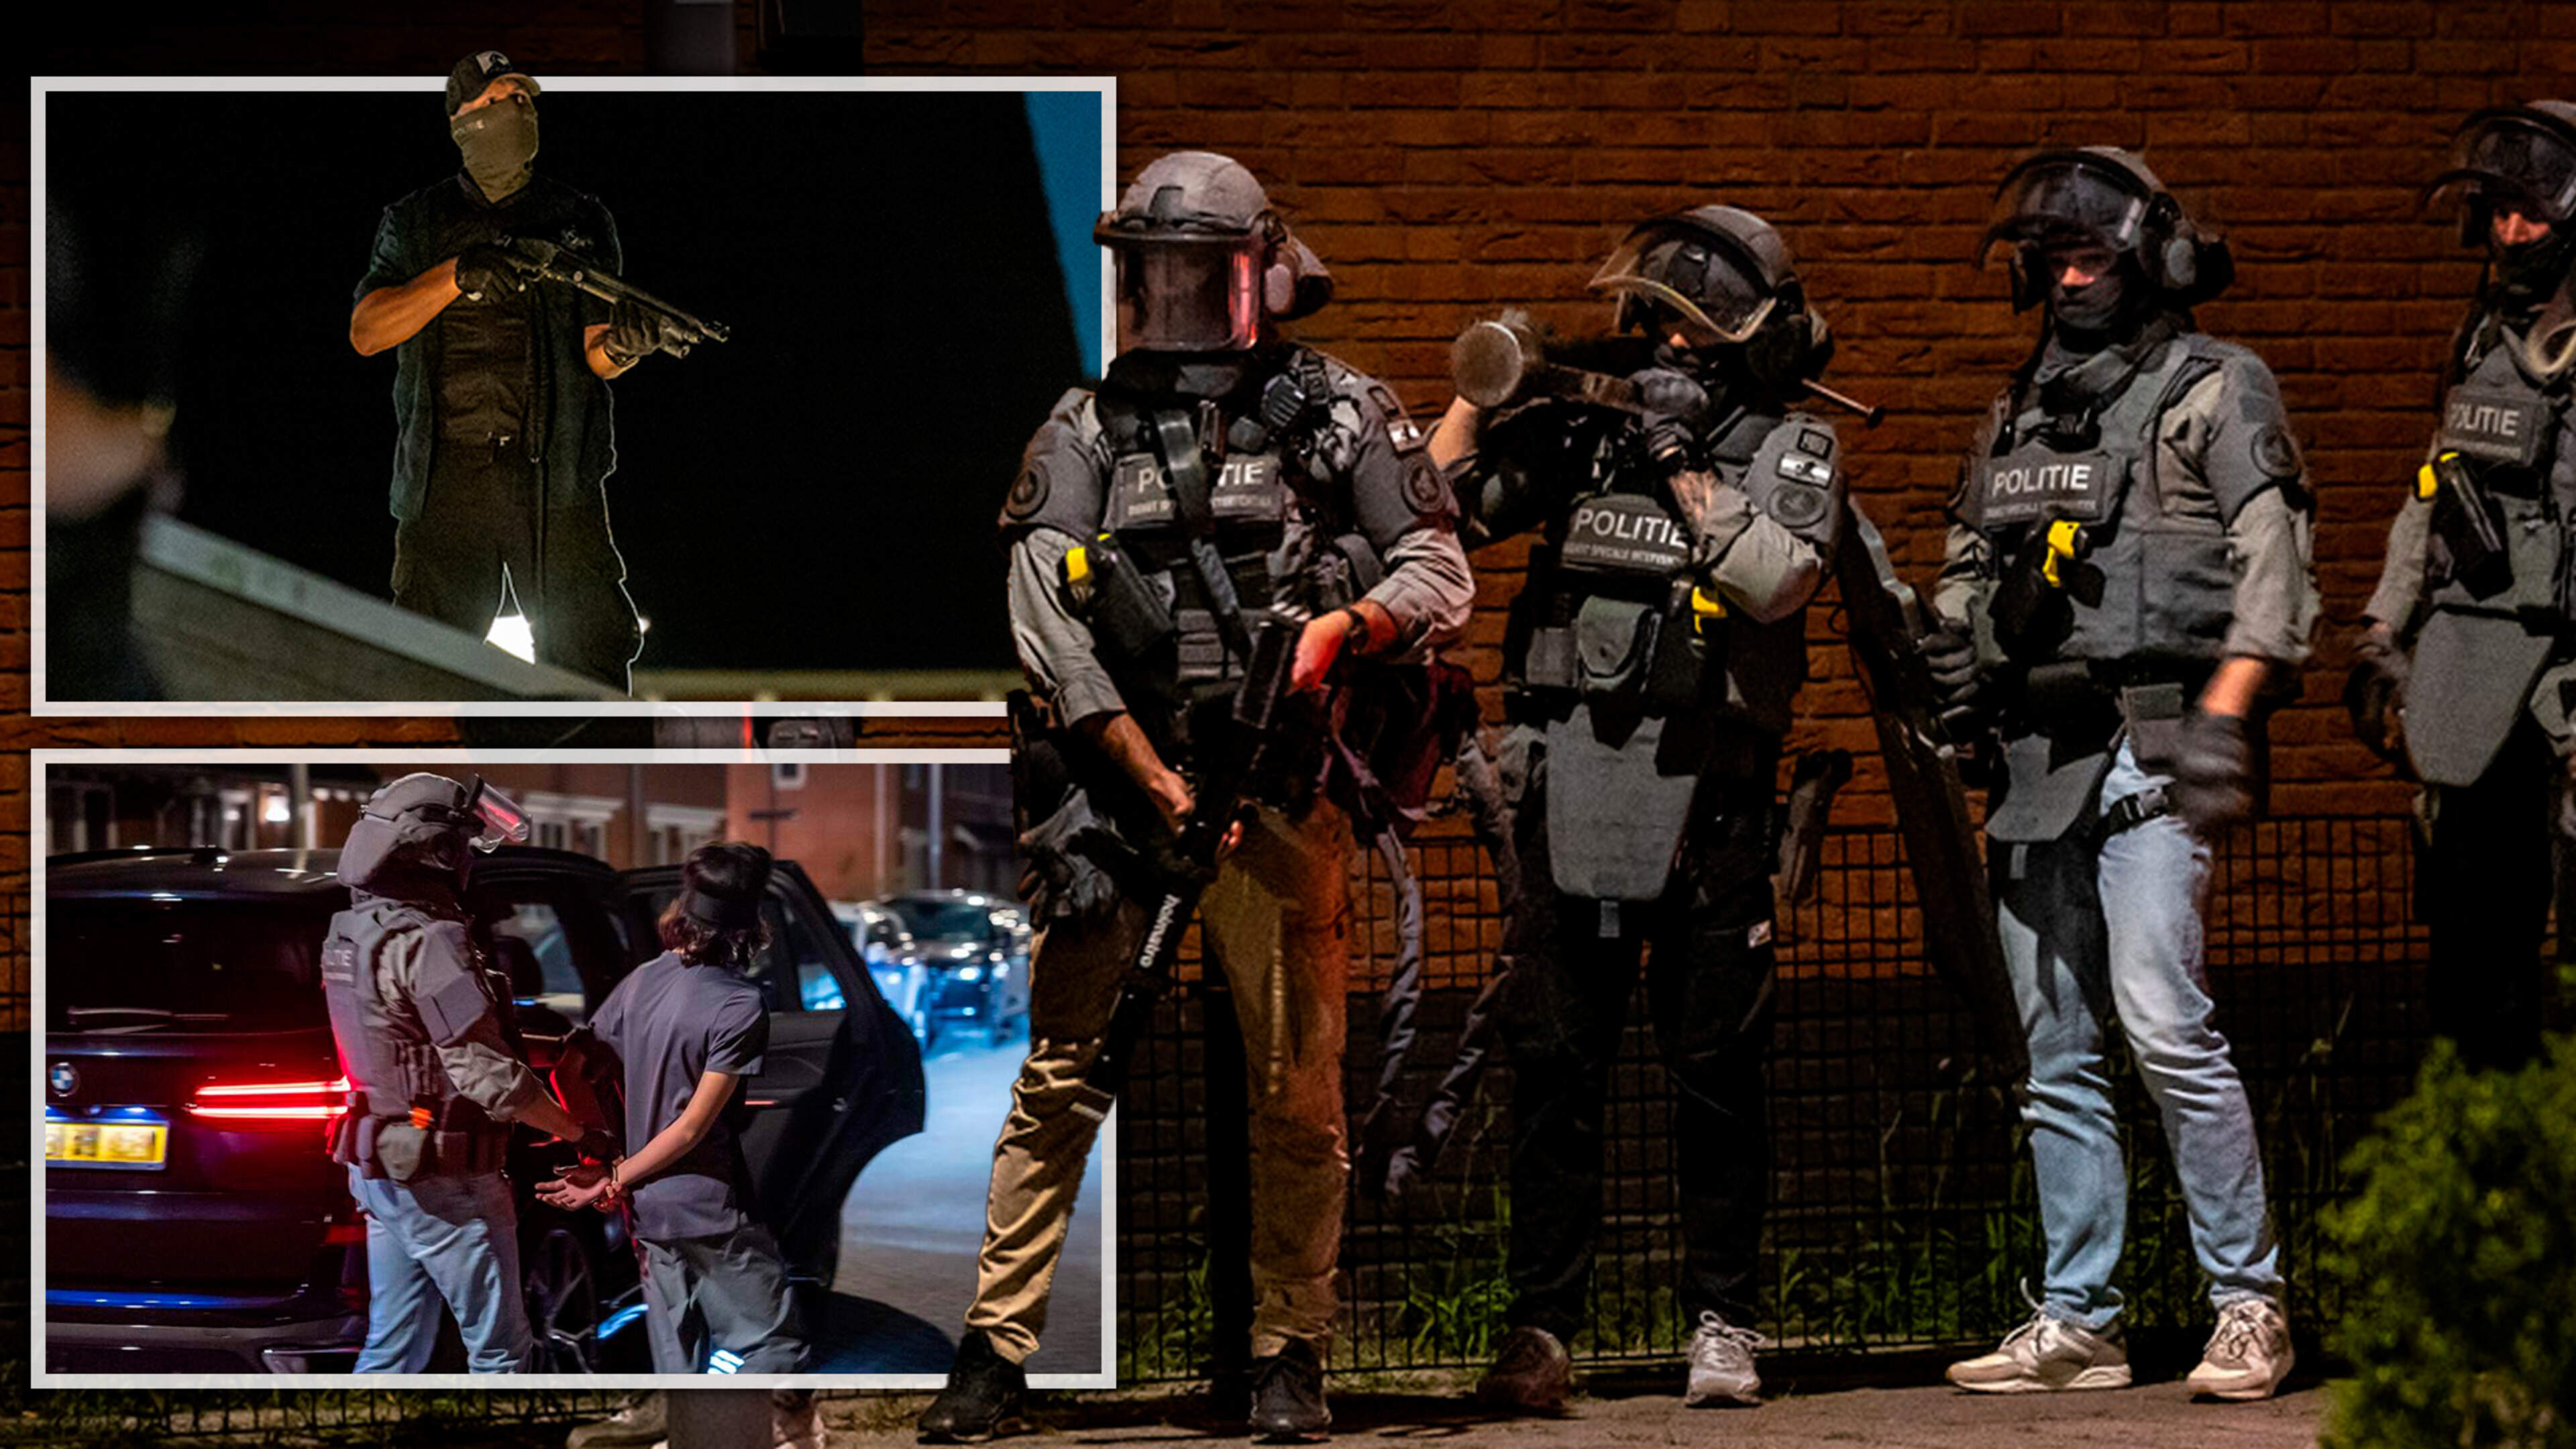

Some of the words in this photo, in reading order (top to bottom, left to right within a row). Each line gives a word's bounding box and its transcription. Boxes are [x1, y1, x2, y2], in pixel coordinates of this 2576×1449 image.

[2449, 402, 2520, 437] POLITIE
[1137, 461, 1265, 494] POTIE
[1991, 464, 2092, 498] POLITIE
